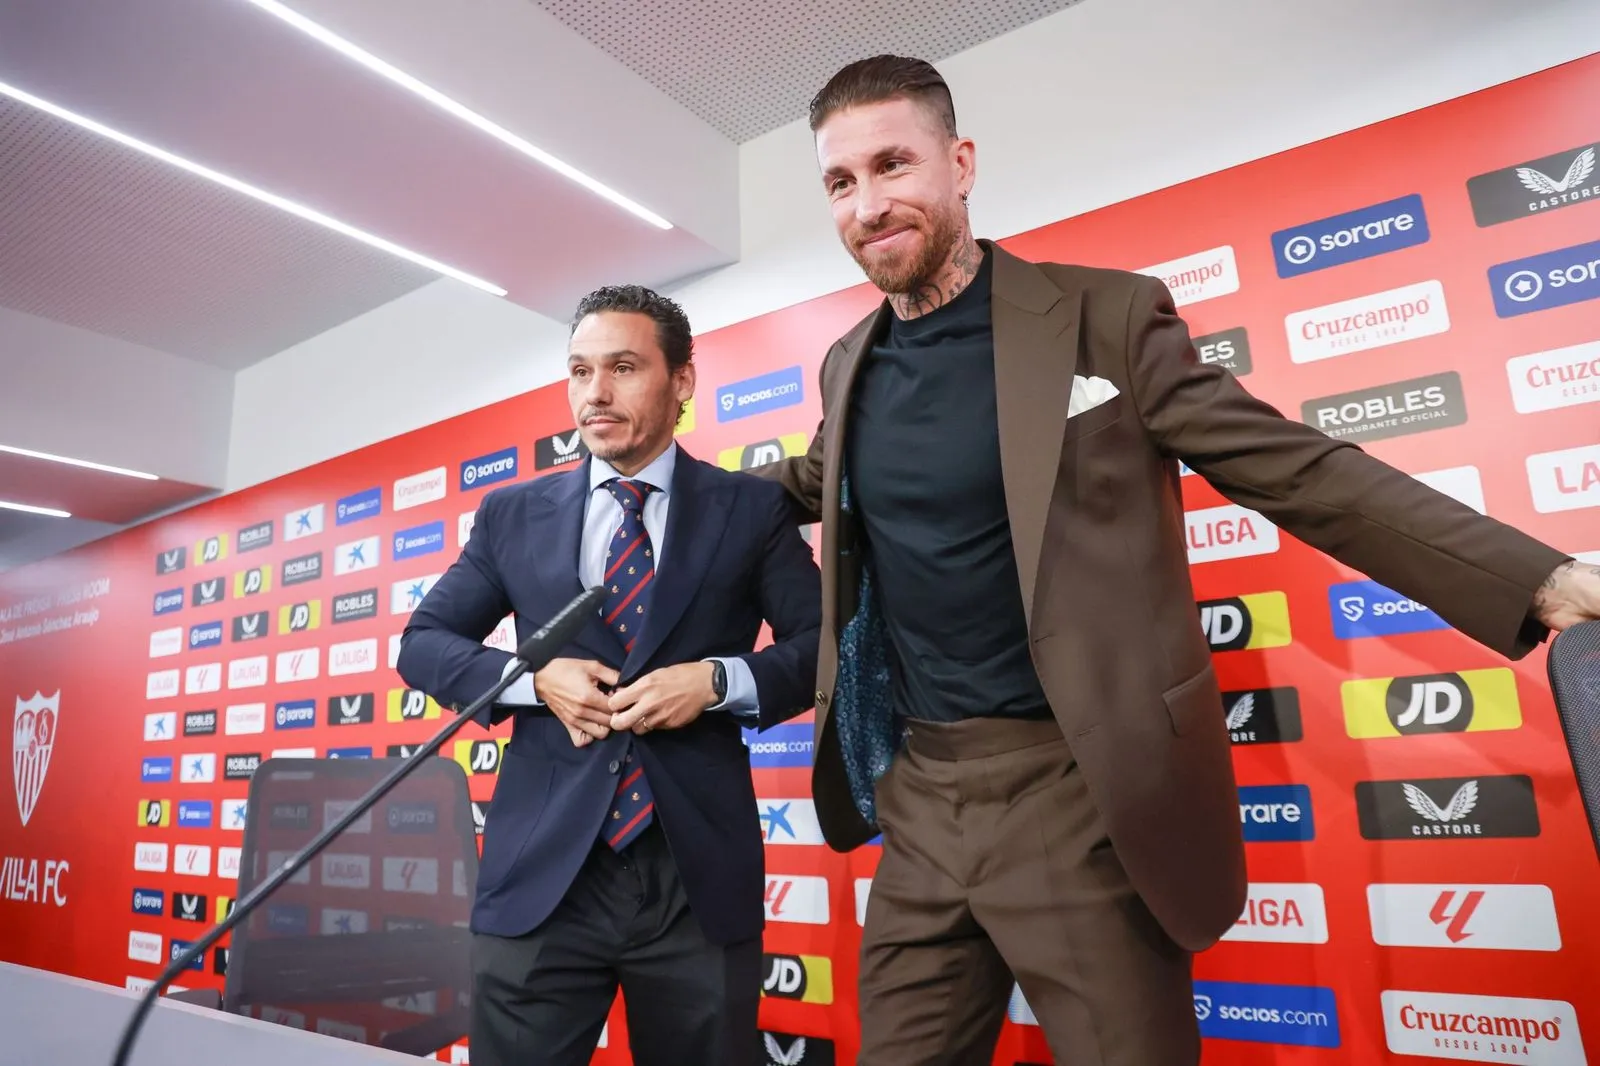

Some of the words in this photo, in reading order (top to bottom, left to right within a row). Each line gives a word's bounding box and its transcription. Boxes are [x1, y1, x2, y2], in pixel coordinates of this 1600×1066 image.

[1529, 186, 1600, 211] CASTORE
[1319, 213, 1414, 251] sorare
[1302, 299, 1430, 340] Cruzcampo
[1317, 387, 1446, 428] ROBLES
[1402, 411, 1449, 425] OFICIAL
[477, 457, 514, 478] sorare
[751, 444, 780, 468] JD
[1188, 517, 1257, 550] LIGA
[203, 540, 219, 561] JD
[245, 569, 261, 594] JD
[335, 594, 374, 613] ROBLES
[291, 604, 309, 629] JD
[334, 648, 370, 668] LALIGA
[403, 689, 425, 716] JD
[1396, 681, 1463, 727] JD
[1229, 732, 1257, 743] ORE
[472, 743, 498, 770] JD
[147, 802, 160, 824] JD
[1239, 803, 1301, 824] rare
[1412, 824, 1482, 836] CASTORE
[43, 860, 69, 907] FC
[764, 958, 801, 993] JD
[1399, 1004, 1560, 1043] Cruzcampo
[1434, 1038, 1478, 1051] DESDE
